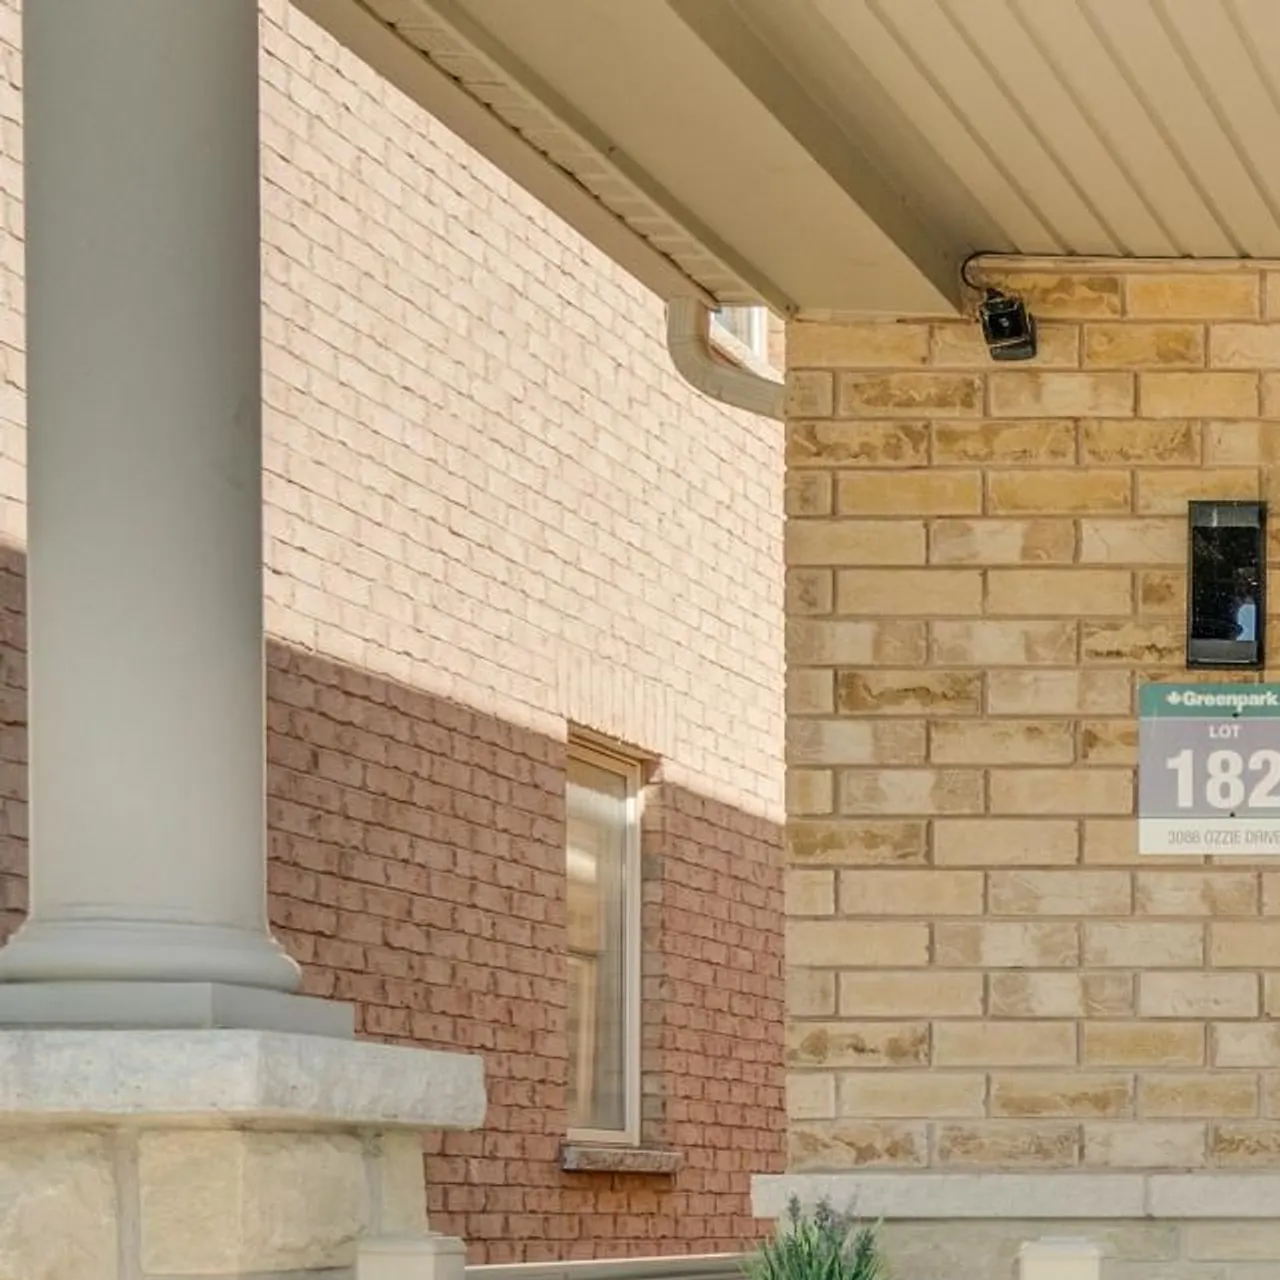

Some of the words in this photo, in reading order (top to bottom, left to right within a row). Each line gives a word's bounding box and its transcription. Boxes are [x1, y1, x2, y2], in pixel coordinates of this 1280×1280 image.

[1183, 691, 1278, 713] Greenpark
[1209, 725, 1241, 738] LOT
[1204, 829, 1241, 845] OZZIE
[1245, 829, 1280, 845] DRIVE
